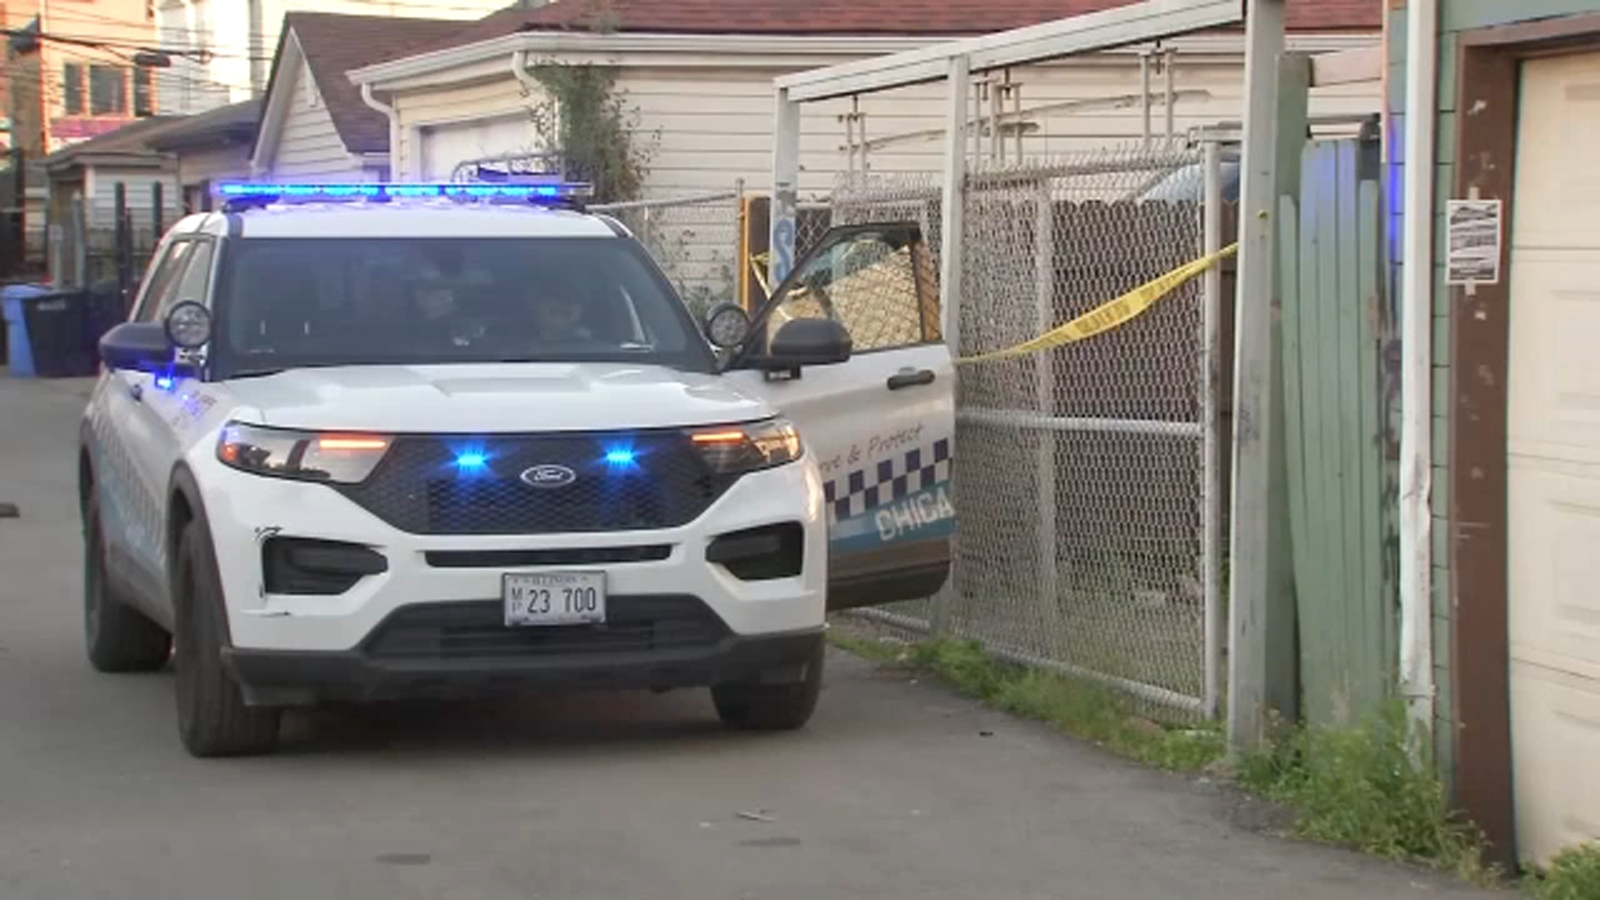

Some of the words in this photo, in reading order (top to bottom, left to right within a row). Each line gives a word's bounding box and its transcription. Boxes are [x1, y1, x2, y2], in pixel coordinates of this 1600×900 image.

[875, 487, 955, 541] CHICA
[527, 589, 551, 613] 23
[562, 587, 596, 612] 700
